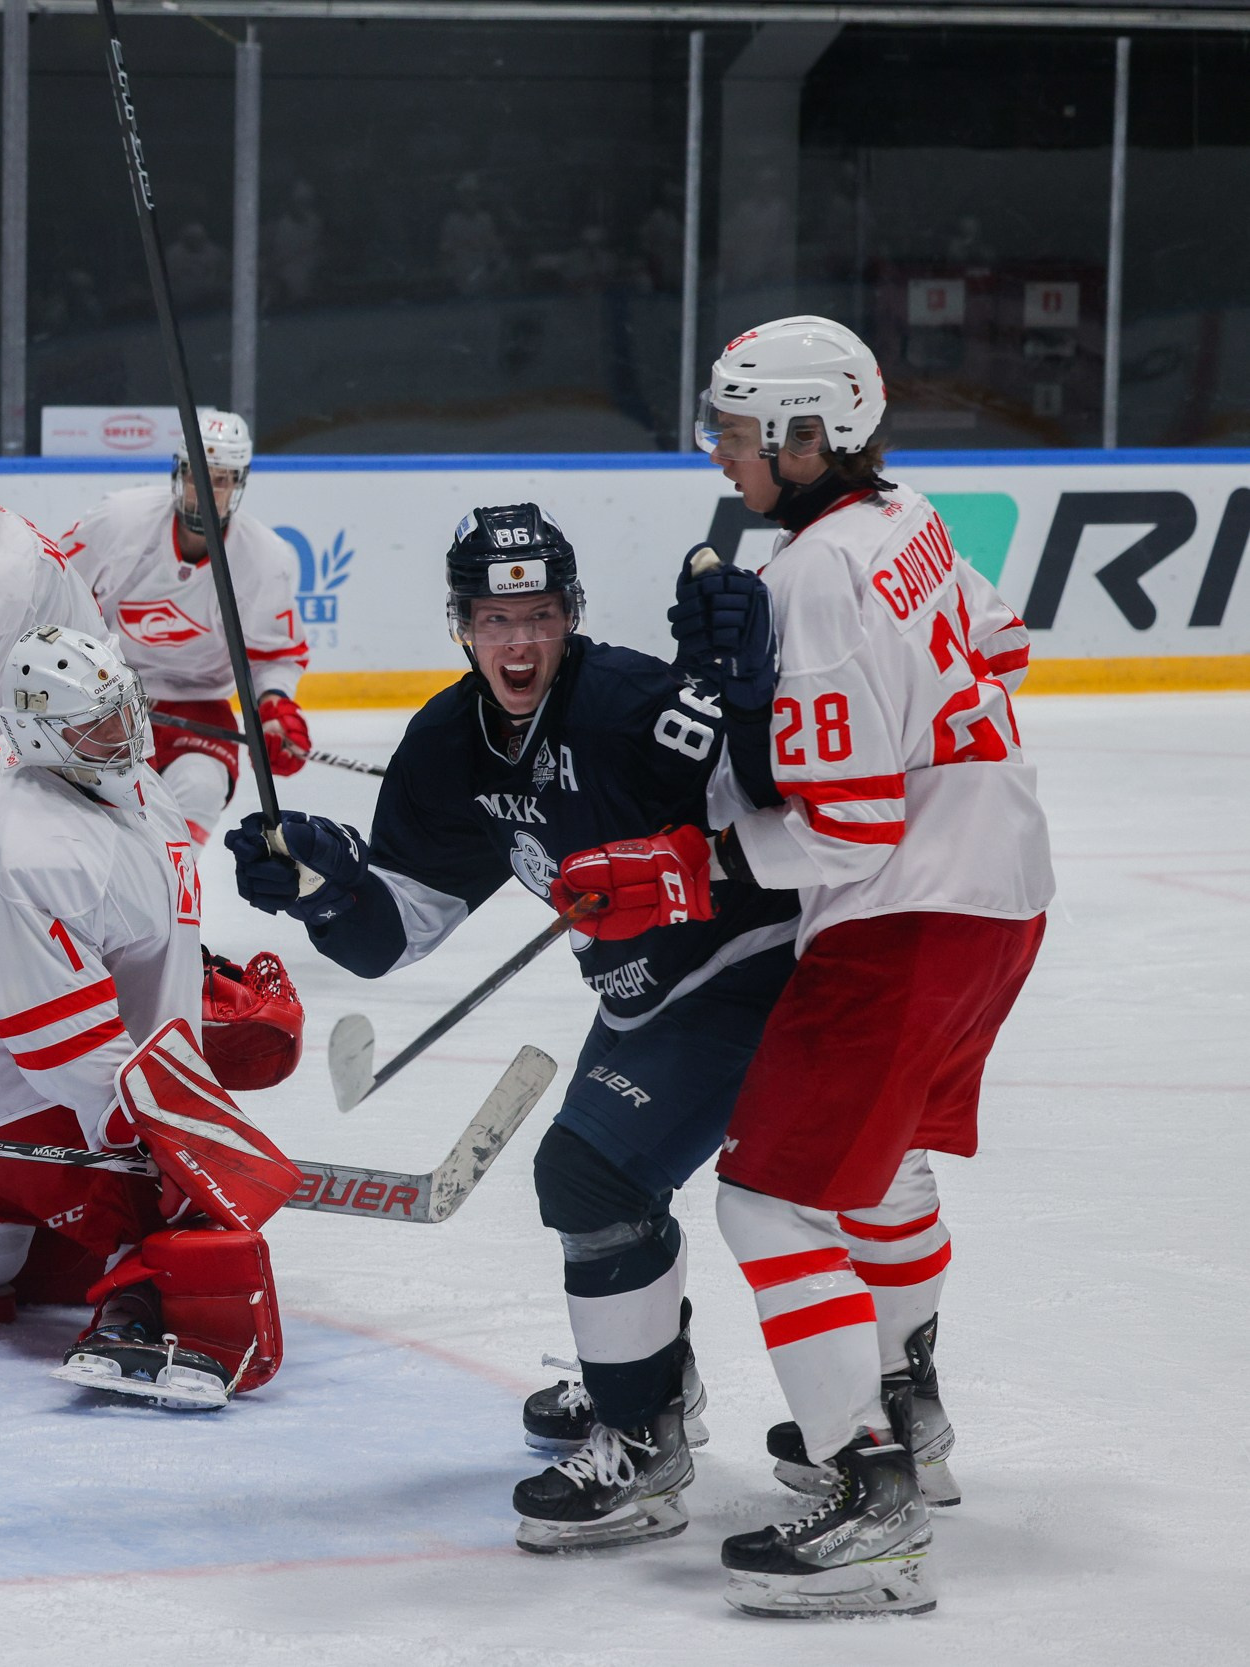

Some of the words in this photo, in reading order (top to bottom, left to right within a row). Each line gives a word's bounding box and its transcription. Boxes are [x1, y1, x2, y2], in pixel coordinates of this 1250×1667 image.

[780, 396, 821, 406] CCM
[496, 527, 530, 547] 86
[497, 580, 540, 591] OLIMPBET
[94, 674, 121, 695] OLIMPBET
[0, 715, 23, 757] BAUER
[773, 692, 853, 768] 28
[559, 744, 579, 791] A
[133, 780, 146, 807] 1
[475, 793, 547, 825] МХК
[661, 868, 689, 925] CC
[49, 918, 85, 973] 1
[586, 1065, 652, 1109] AUER
[31, 1147, 66, 1159] MACH
[293, 1172, 419, 1216] AUER
[44, 1203, 87, 1229] CC
